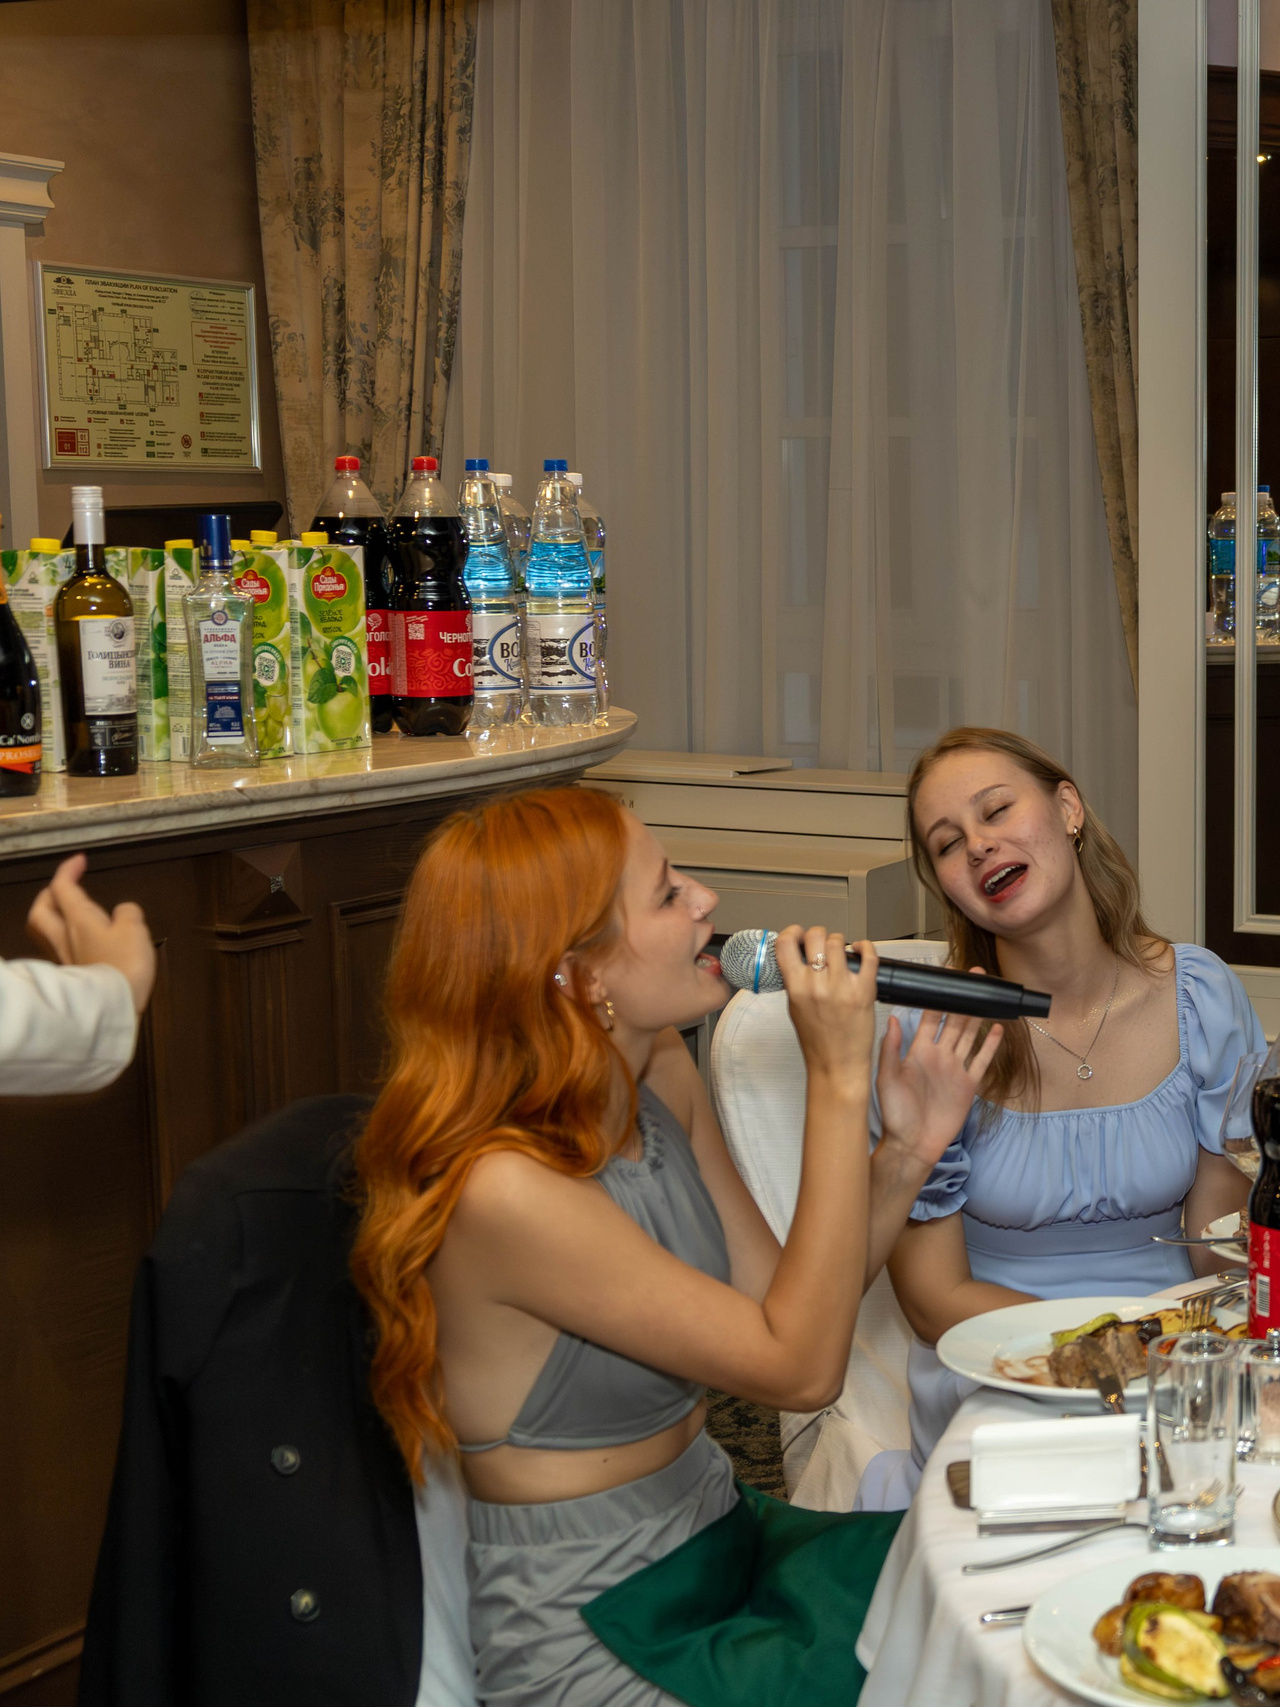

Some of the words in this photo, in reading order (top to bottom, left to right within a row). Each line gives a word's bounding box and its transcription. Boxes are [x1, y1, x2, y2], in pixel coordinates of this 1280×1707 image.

[241, 578, 260, 588] Сады
[319, 575, 337, 584] Сады
[314, 582, 345, 593] Придонья
[203, 633, 237, 643] АЛЬФА
[108, 660, 131, 669] ВИНА
